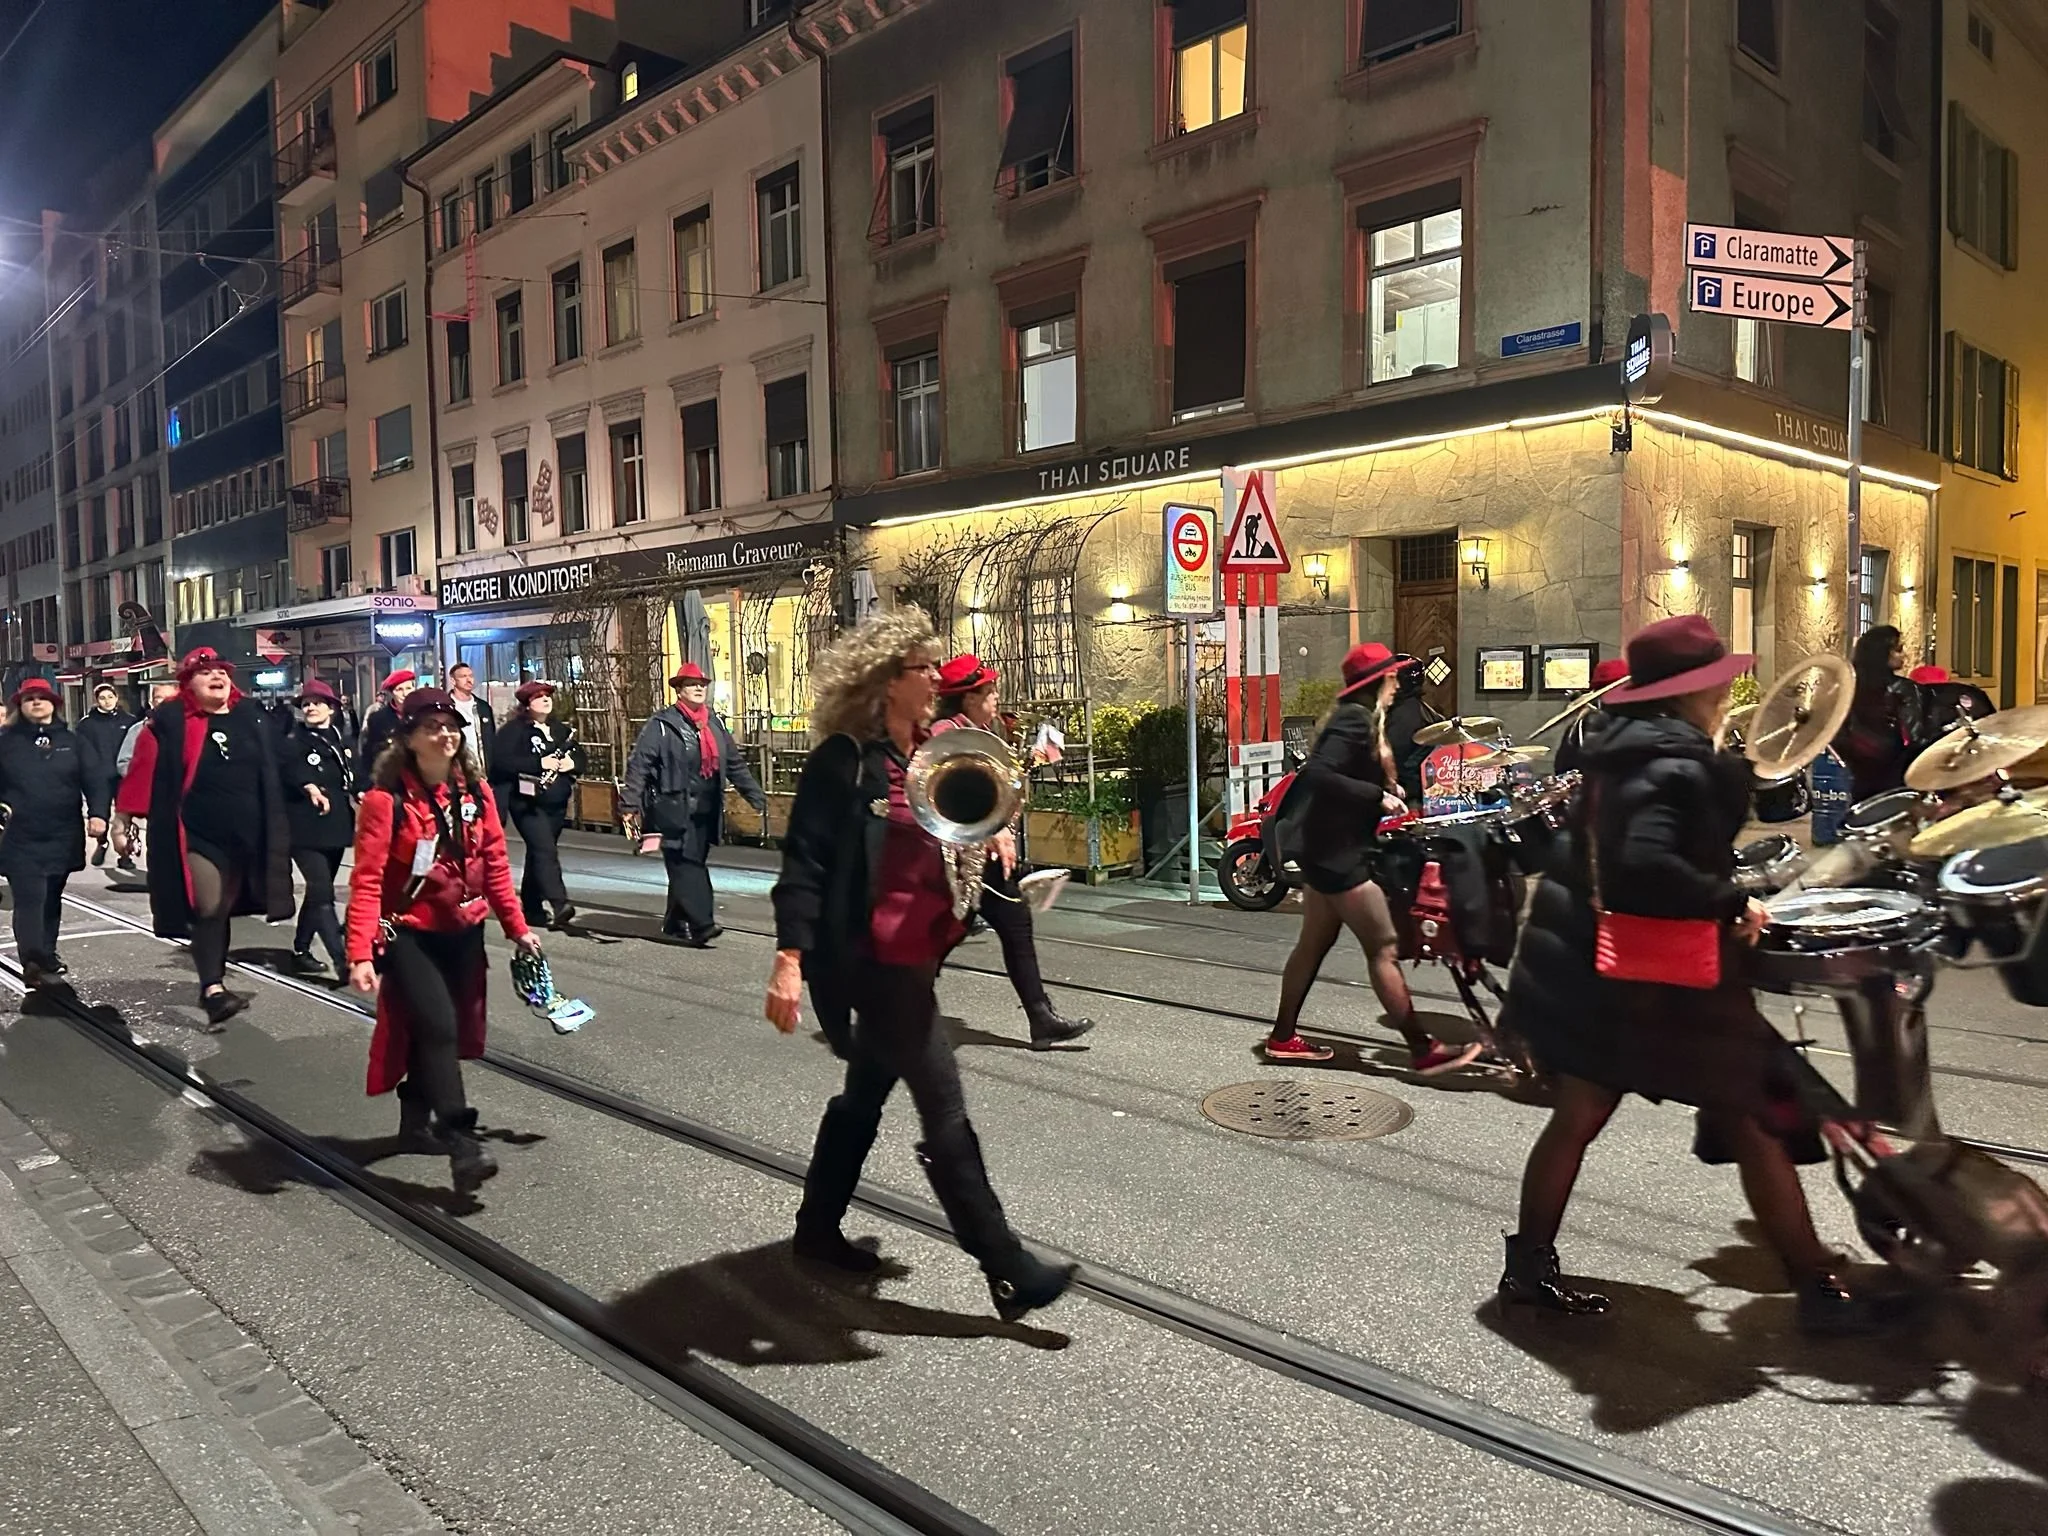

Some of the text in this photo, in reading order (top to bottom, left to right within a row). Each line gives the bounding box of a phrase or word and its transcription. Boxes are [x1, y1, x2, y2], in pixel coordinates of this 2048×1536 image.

[1726, 235, 1818, 267] Claramatte
[1732, 281, 1815, 320] Europe
[1516, 328, 1566, 344] Clarastrasse
[1630, 335, 1647, 357] THAI
[1775, 412, 1847, 453] THAI SQUA
[1038, 446, 1190, 491] THAI SQUARE
[732, 540, 804, 567] Graveure
[442, 562, 593, 606] BÄCKEREI KONDITOREI
[374, 596, 417, 609] sonio.
